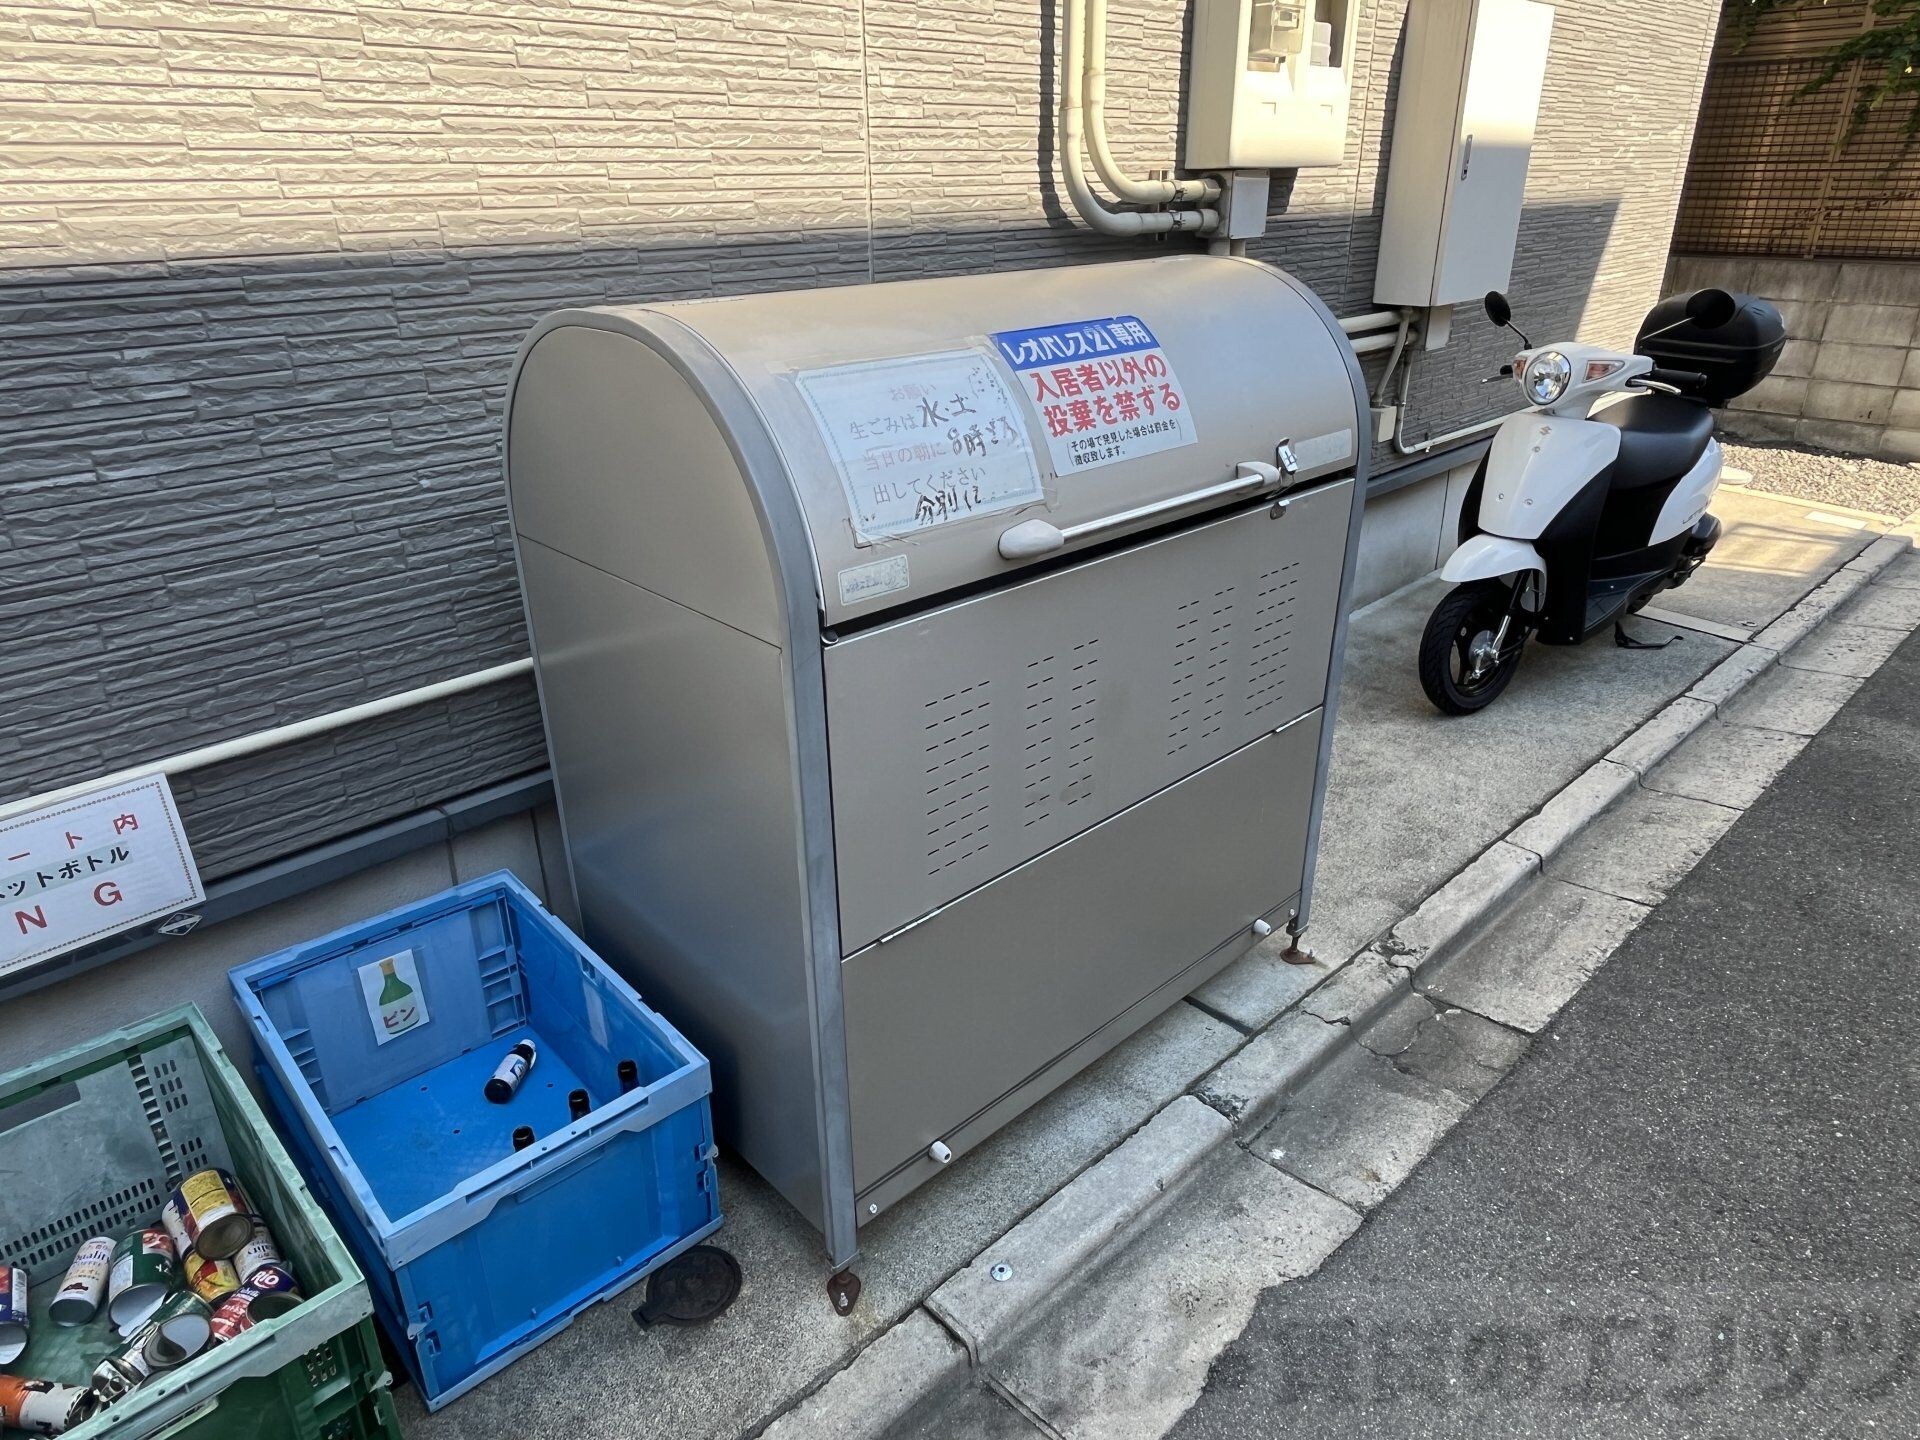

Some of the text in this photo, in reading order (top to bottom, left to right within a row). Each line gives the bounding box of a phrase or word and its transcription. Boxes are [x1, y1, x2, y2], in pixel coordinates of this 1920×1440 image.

[887, 382, 937, 402] お願い
[1029, 353, 1168, 403] 入居者以外の
[1043, 382, 1181, 438] 投棄を禁ずる
[849, 414, 920, 441] 生ごみは
[862, 442, 947, 472] 当日の朝に
[872, 465, 987, 506] 出してください
[383, 1004, 416, 1028] ビン
